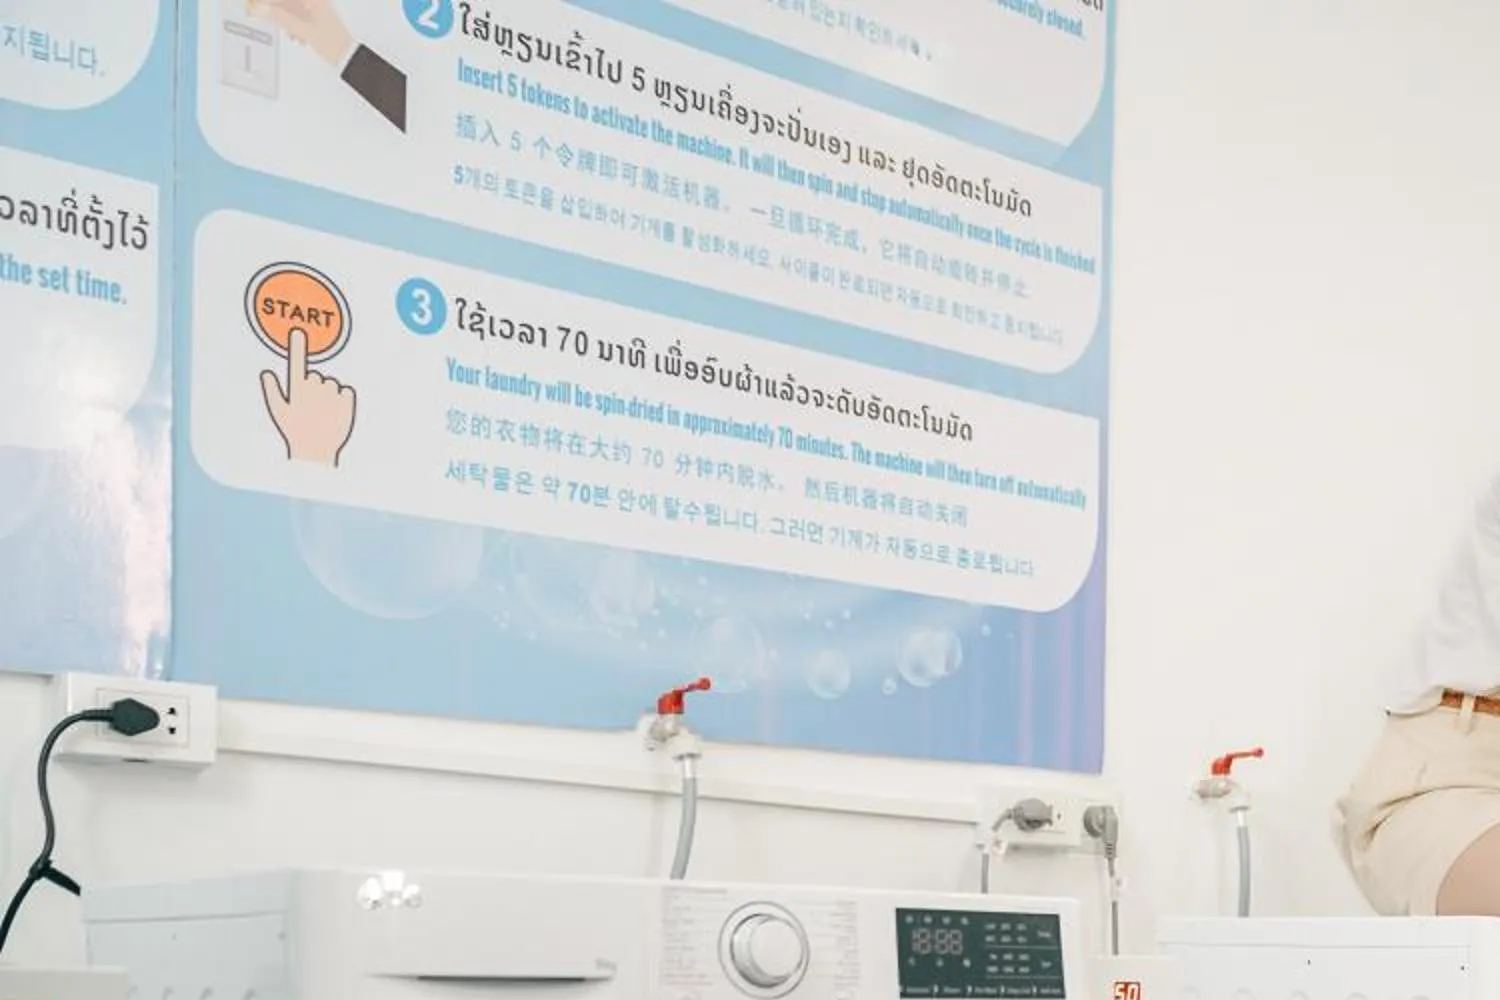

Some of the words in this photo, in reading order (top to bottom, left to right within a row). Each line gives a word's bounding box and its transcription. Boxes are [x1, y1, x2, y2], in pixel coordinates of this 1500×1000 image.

[416, 0, 440, 30] 2
[632, 66, 645, 91] 5
[859, 145, 896, 172] ແລະ
[511, 130, 522, 152] 5
[457, 56, 503, 94] Insert
[507, 72, 518, 98] 5
[521, 78, 571, 115] tokens
[574, 96, 589, 120] to
[591, 105, 648, 139] activate
[651, 119, 674, 146] the
[677, 132, 737, 167] machine.
[740, 147, 750, 169] It
[753, 154, 775, 177] will
[778, 160, 806, 186] then
[808, 173, 833, 197] spin
[836, 181, 858, 203] and
[861, 187, 886, 213] stop
[889, 198, 963, 237] automatically
[967, 223, 993, 245] once
[995, 226, 1013, 251] the
[1056, 246, 1095, 275] finished
[38, 265, 70, 294] set
[76, 269, 127, 305] time.
[262, 297, 335, 328] START
[410, 288, 432, 326] 3
[557, 326, 588, 356] 70
[447, 357, 480, 385] Your
[485, 365, 541, 402] laundry
[545, 381, 571, 405] will
[575, 384, 592, 409] be
[668, 404, 680, 426] in
[683, 413, 774, 448] approximately
[778, 426, 793, 449] 70
[796, 433, 848, 460] minutes.
[851, 441, 871, 465] The
[875, 450, 922, 476] machine
[925, 459, 945, 480] will
[947, 463, 972, 487] then
[974, 469, 997, 492] turn
[1000, 475, 1014, 495] off
[1017, 480, 1087, 512] automatically
[641, 447, 664, 468] 70
[445, 459, 534, 495] 세탁물은
[617, 488, 657, 516] 안에
